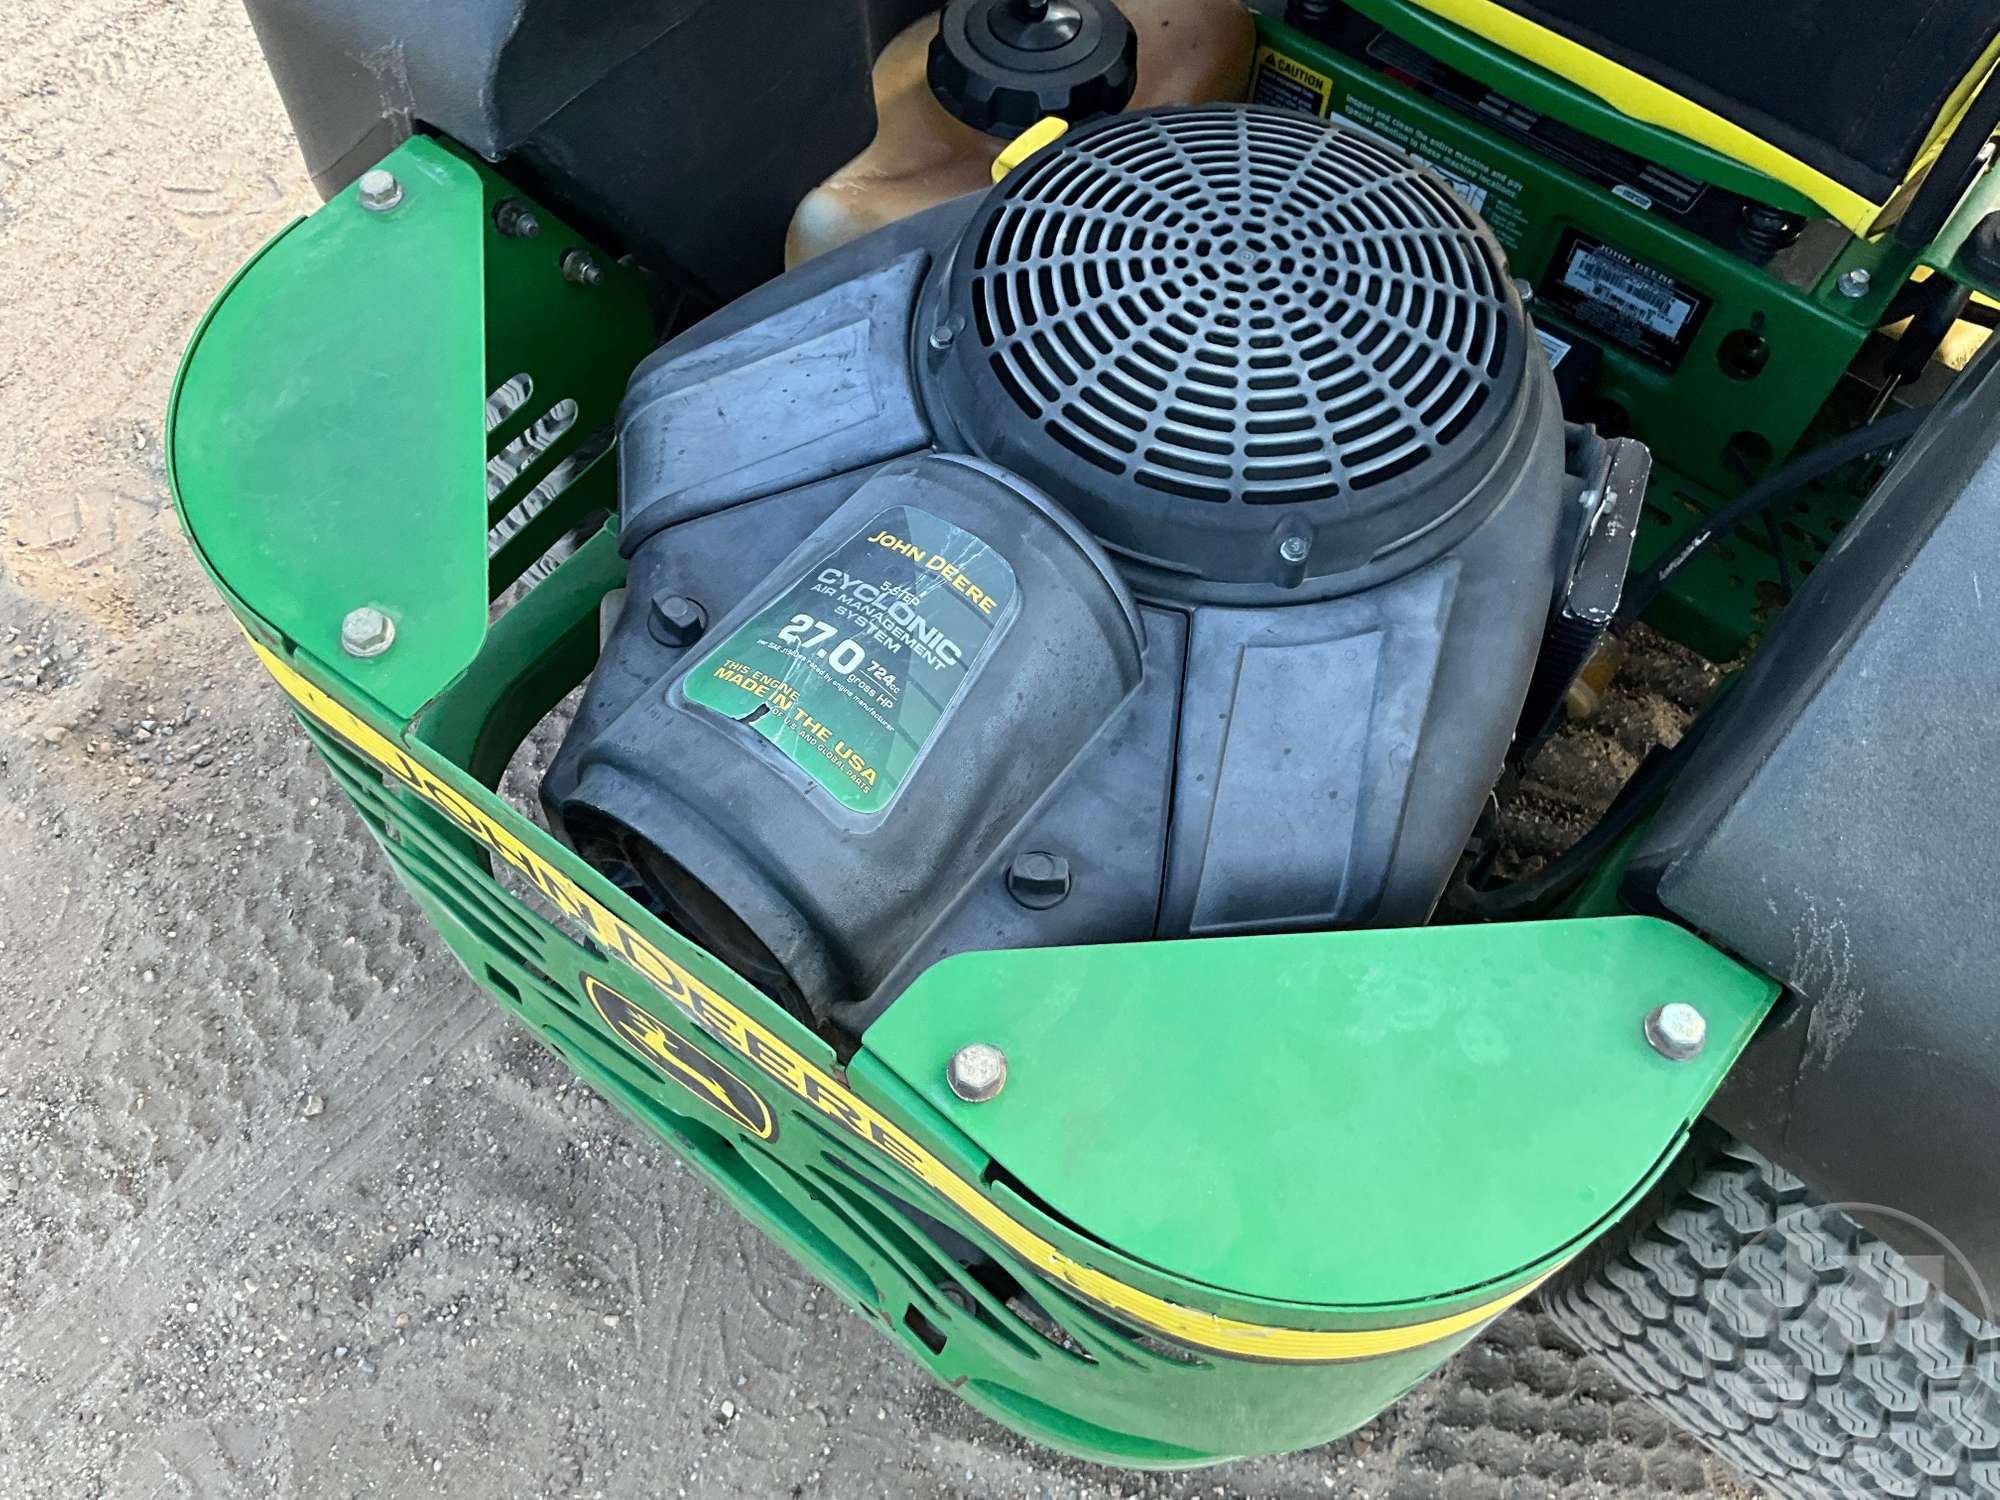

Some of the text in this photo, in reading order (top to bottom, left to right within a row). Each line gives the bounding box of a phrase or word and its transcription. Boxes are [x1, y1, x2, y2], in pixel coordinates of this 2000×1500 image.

[1277, 59, 1324, 90] CAUTION
[1346, 93, 1375, 114] Inspect
[1376, 109, 1392, 123] and
[1392, 115, 1415, 134] clean
[1415, 127, 1429, 142] the
[1430, 136, 1454, 154] entire
[1455, 149, 1489, 174] machine
[1490, 168, 1507, 183] and
[1409, 136, 1419, 148] to
[1419, 142, 1442, 160] these
[1443, 154, 1477, 179] machine
[1600, 244, 1675, 286] JOHN DEERE
[867, 530, 998, 615] JOHN DEERE
[879, 580, 921, 607] 5-STEP
[777, 613, 866, 675] 27.0
[810, 583, 948, 672] AIR MANAGEMENT
[816, 567, 962, 666] CYCLONIC
[833, 605, 903, 654] SYSTEM
[723, 659, 801, 701] THIS ENGINE
[807, 659, 825, 676] rated
[824, 670, 833, 682] by
[832, 679, 854, 698] engine
[852, 695, 896, 732] manufacturer
[846, 673, 895, 710] gross HP
[866, 660, 901, 694] 724cc
[713, 666, 878, 786] MADE IN THE USA
[771, 706, 785, 719] OF
[798, 730, 818, 746] AND
[817, 743, 846, 772] GLOBAL
[846, 769, 872, 794] PARTS
[384, 752, 928, 1177] JOHN DEERE
